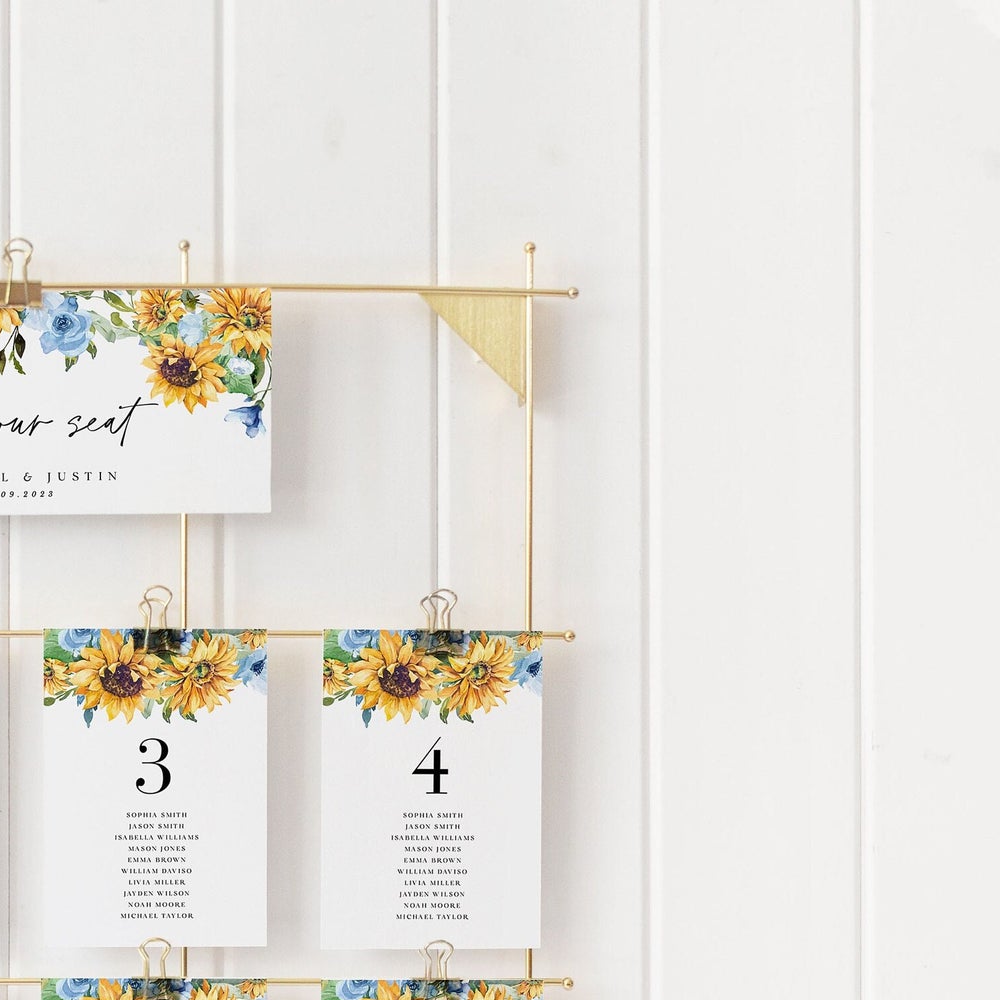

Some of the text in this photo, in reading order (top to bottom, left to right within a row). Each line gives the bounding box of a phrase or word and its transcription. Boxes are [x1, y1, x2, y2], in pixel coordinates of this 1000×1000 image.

[67, 396, 160, 447] seat
[23, 471, 34, 483] &
[47, 471, 118, 484] JUSTIN
[135, 737, 172, 795] 3
[411, 736, 449, 795] 4
[402, 811, 434, 819] SOPHIA
[128, 823, 155, 831] JASON
[432, 834, 475, 842] WILLIAMS
[160, 845, 186, 853] JONES
[161, 867, 193, 875] DAVISO
[430, 879, 461, 887] MILLER
[123, 890, 154, 898] JAYDEN
[120, 912, 194, 920] MICHAEL TAYLOR
